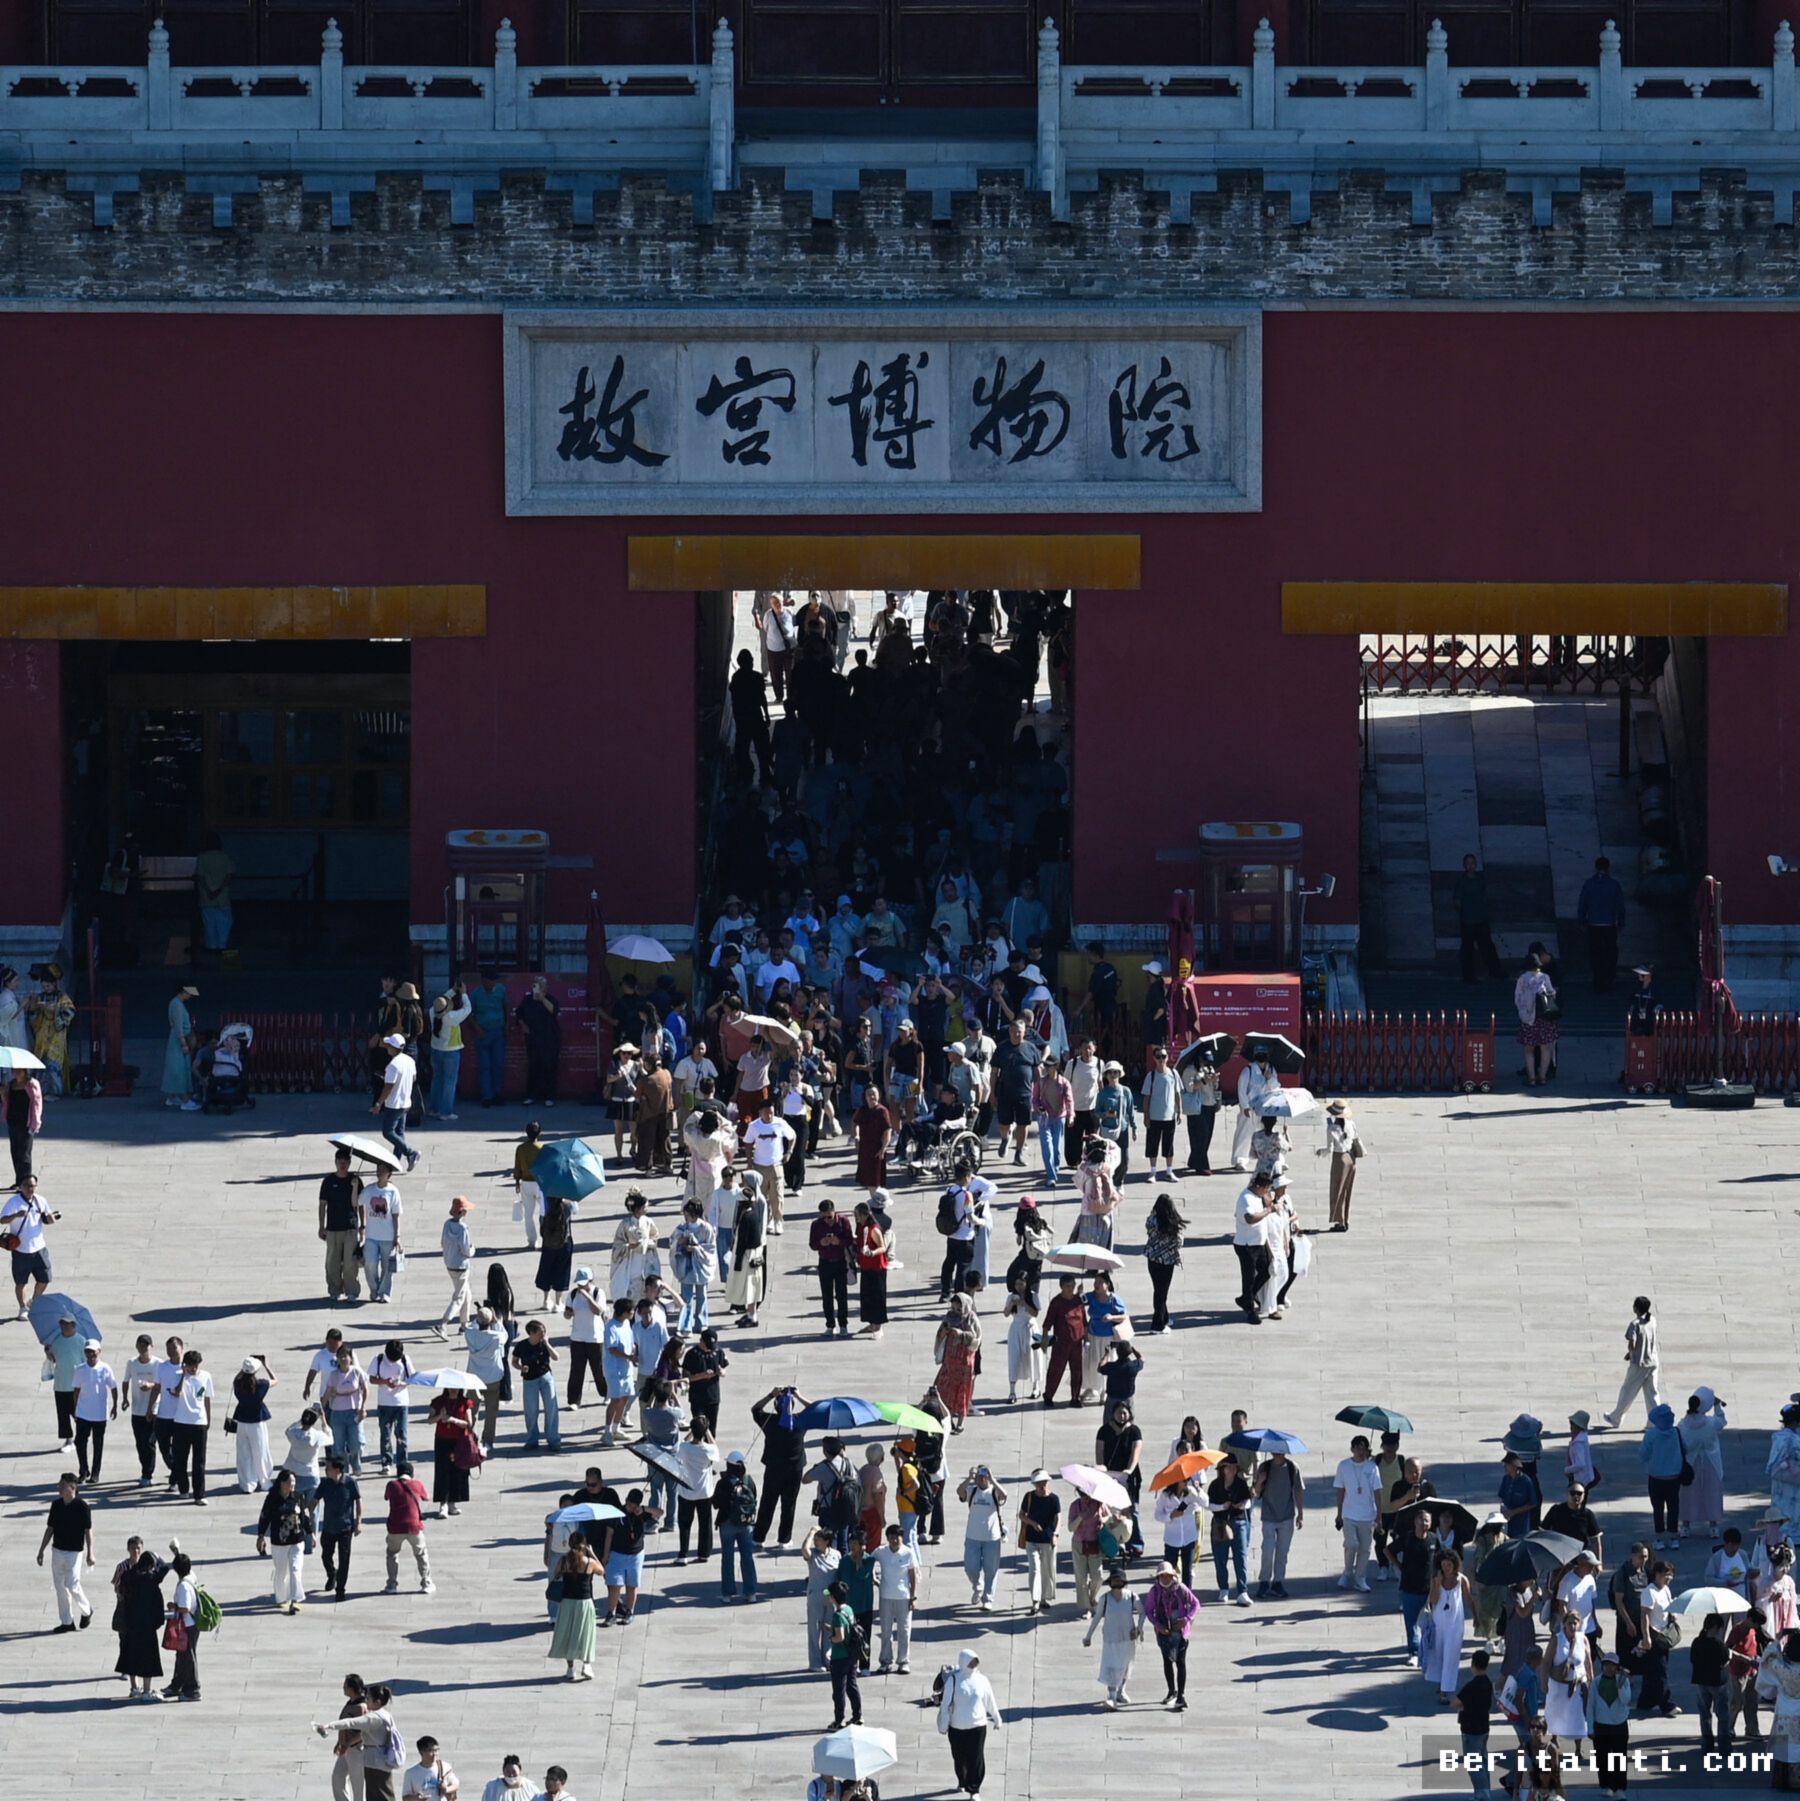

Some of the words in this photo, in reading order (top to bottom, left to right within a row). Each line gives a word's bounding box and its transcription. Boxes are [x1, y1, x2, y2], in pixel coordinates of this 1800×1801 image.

[556, 351, 1201, 469] 故宫博物院
